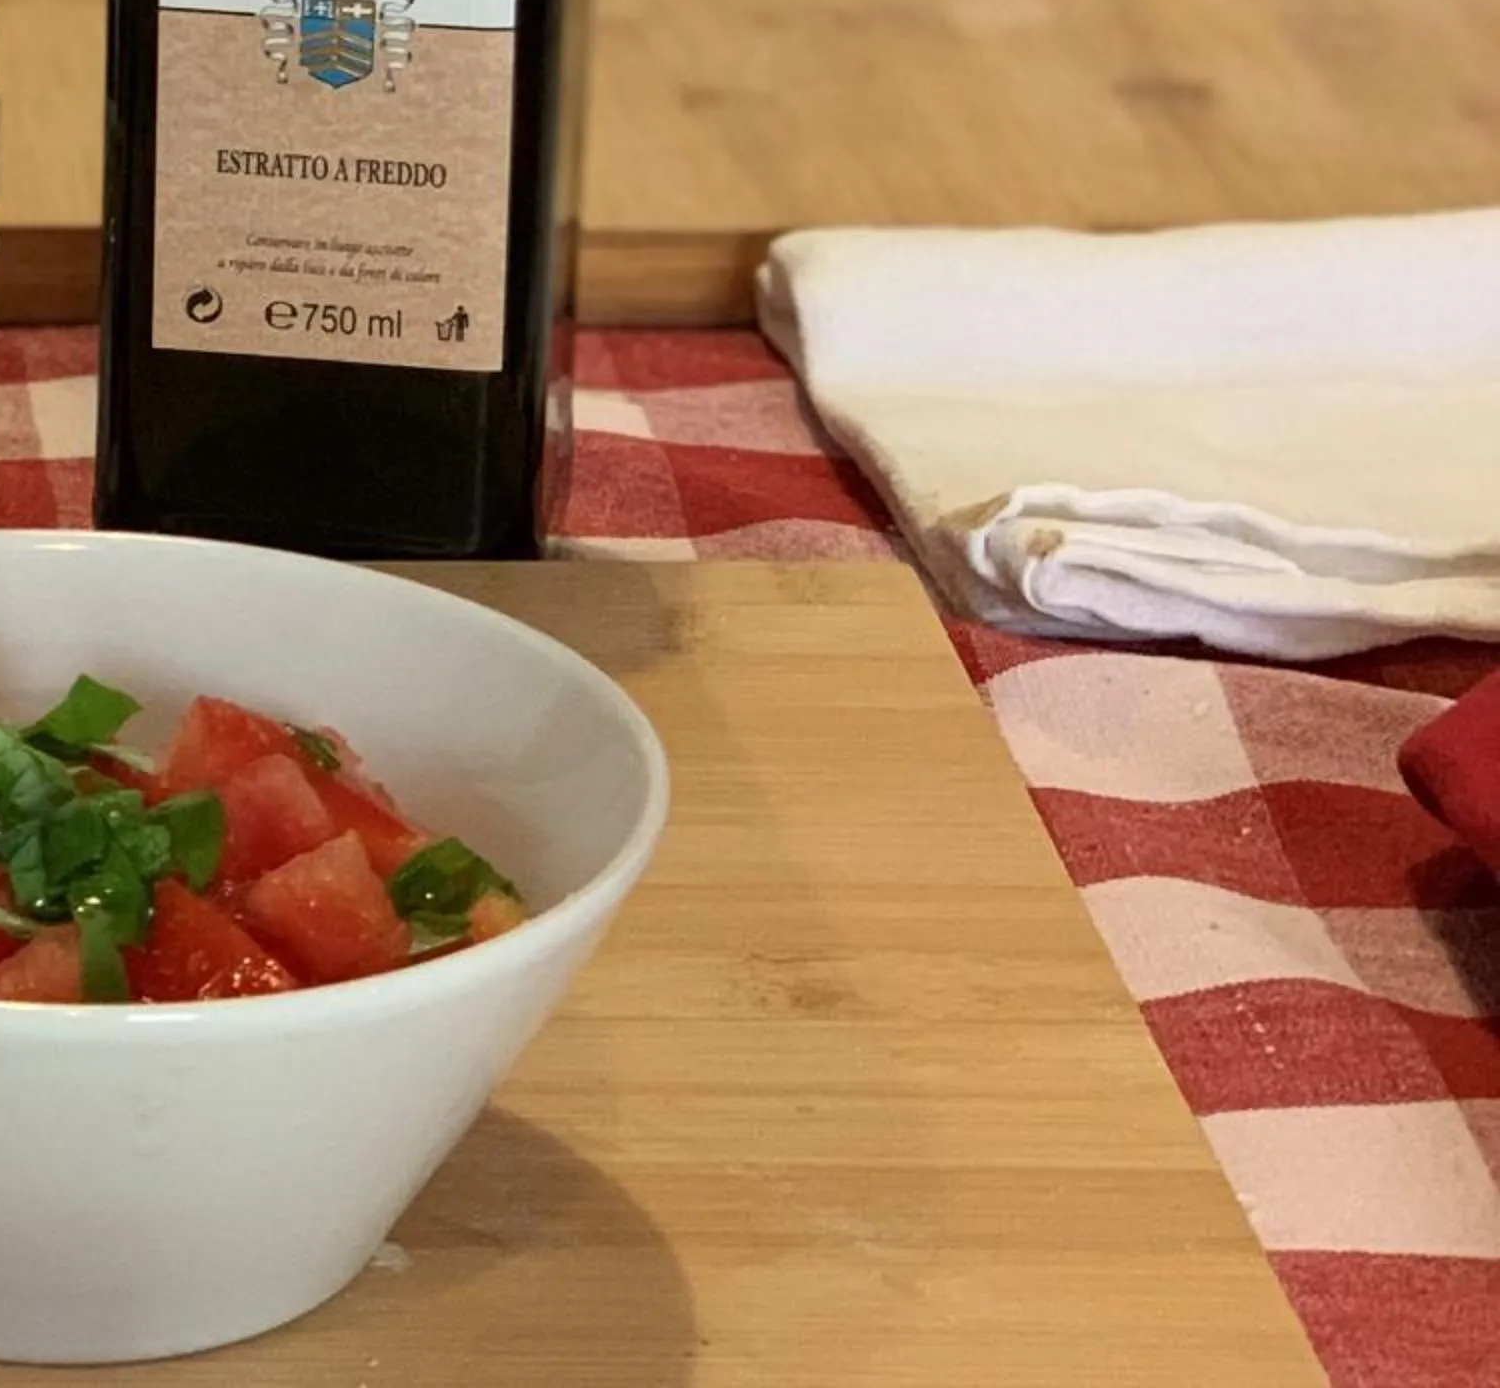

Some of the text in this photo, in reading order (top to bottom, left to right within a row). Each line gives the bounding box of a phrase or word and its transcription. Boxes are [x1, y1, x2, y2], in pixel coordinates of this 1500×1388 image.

[216, 148, 447, 189] ESTRATTO A FREDDO
[366, 309, 402, 339] ml
